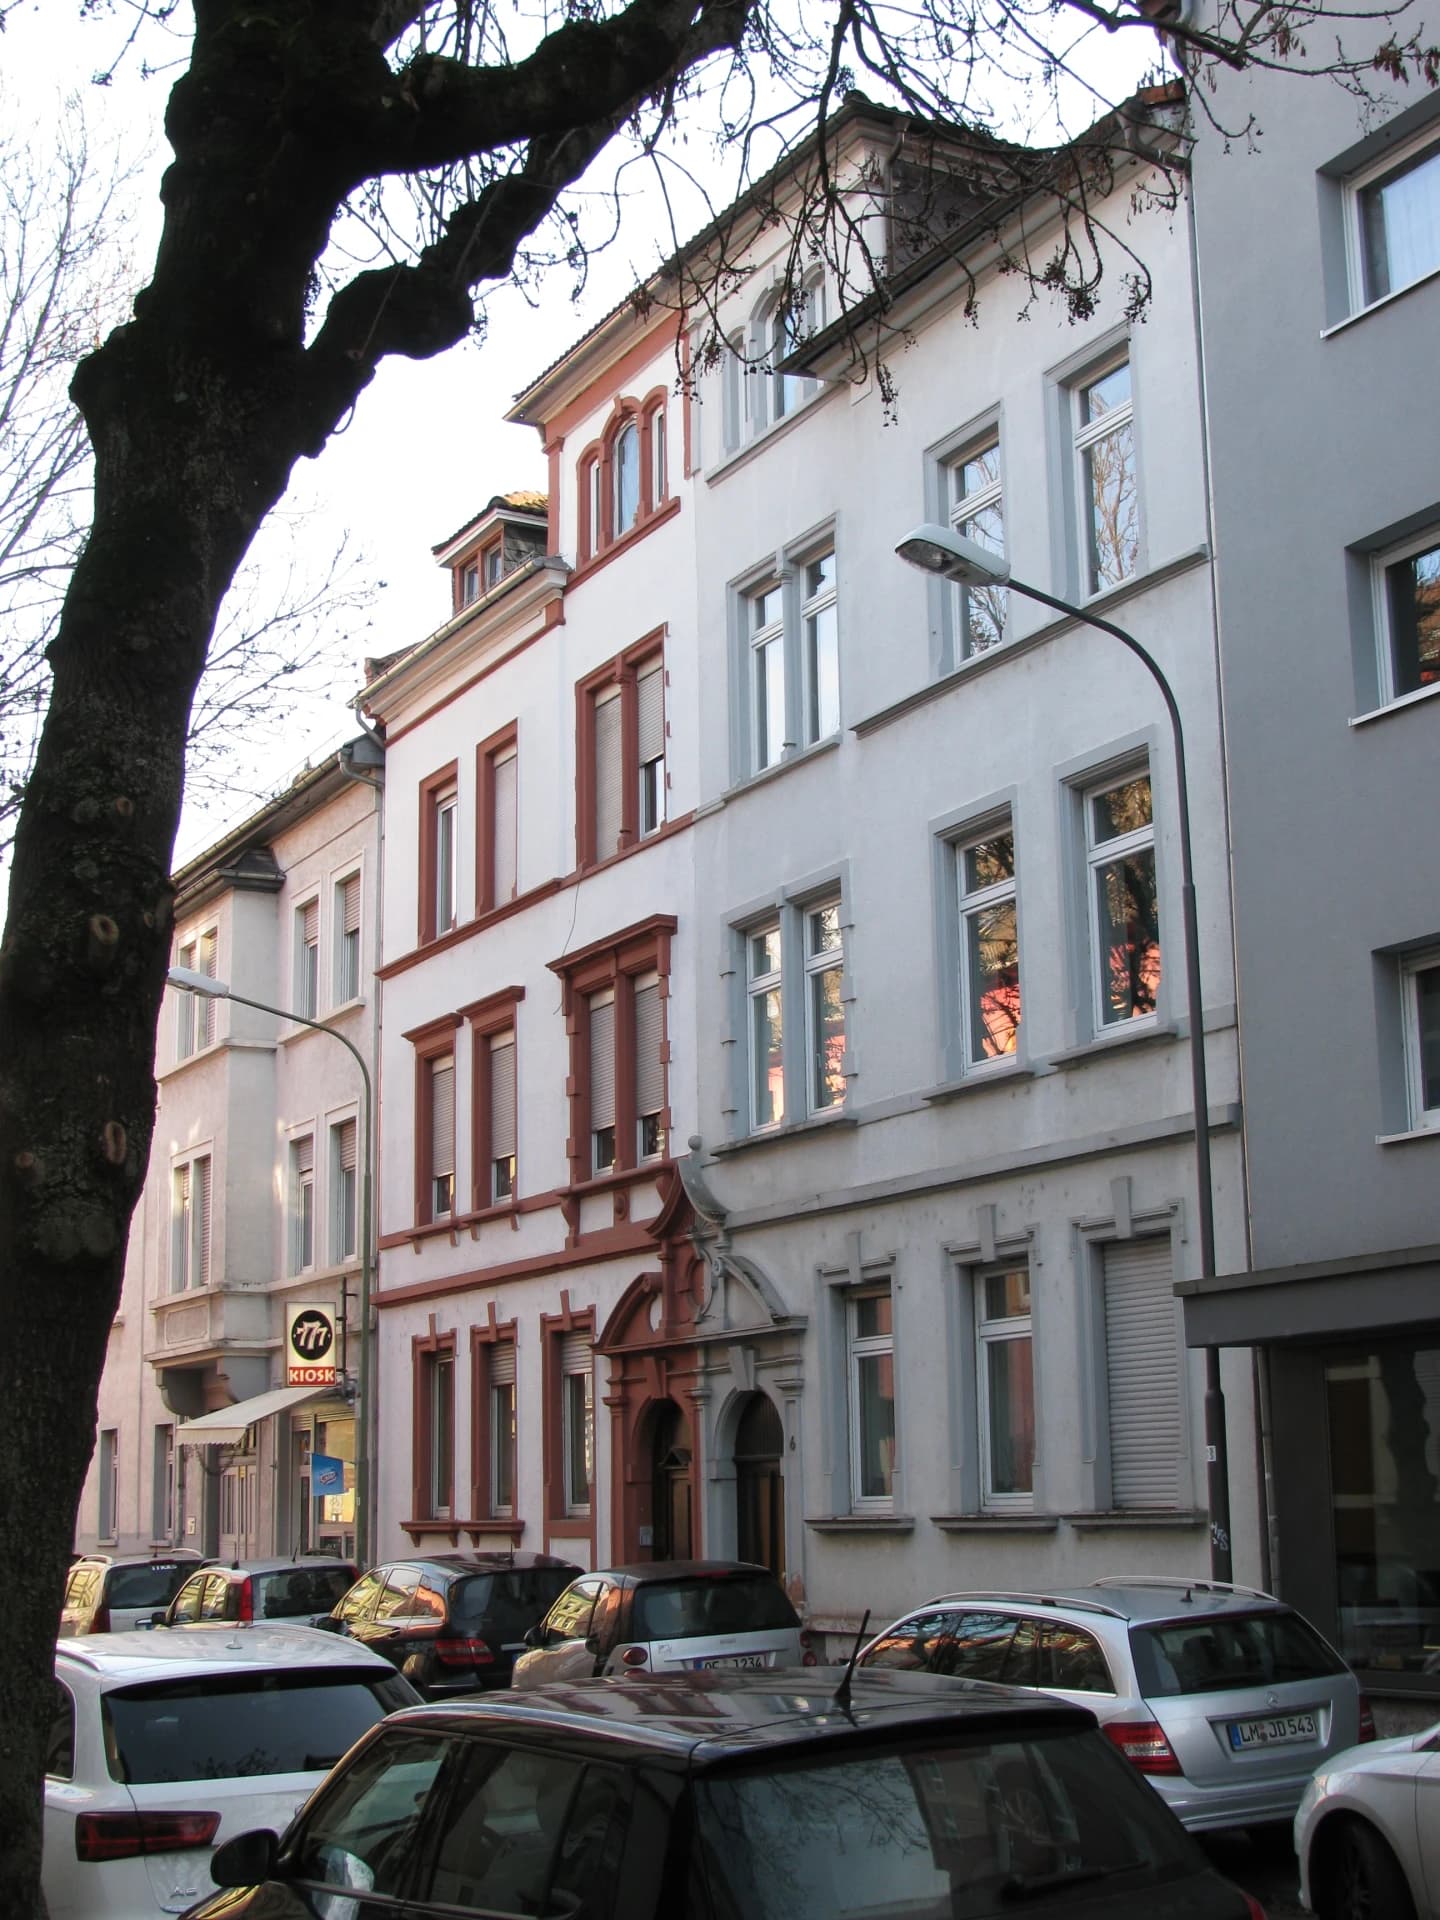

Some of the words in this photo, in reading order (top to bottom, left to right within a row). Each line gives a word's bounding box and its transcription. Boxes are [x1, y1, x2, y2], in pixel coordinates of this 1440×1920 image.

[296, 1321, 328, 1350] 777
[289, 1368, 334, 1382] KIOSK
[789, 1435, 796, 1451] 6
[1240, 1724, 1260, 1742] LM
[1288, 1717, 1314, 1735] 543
